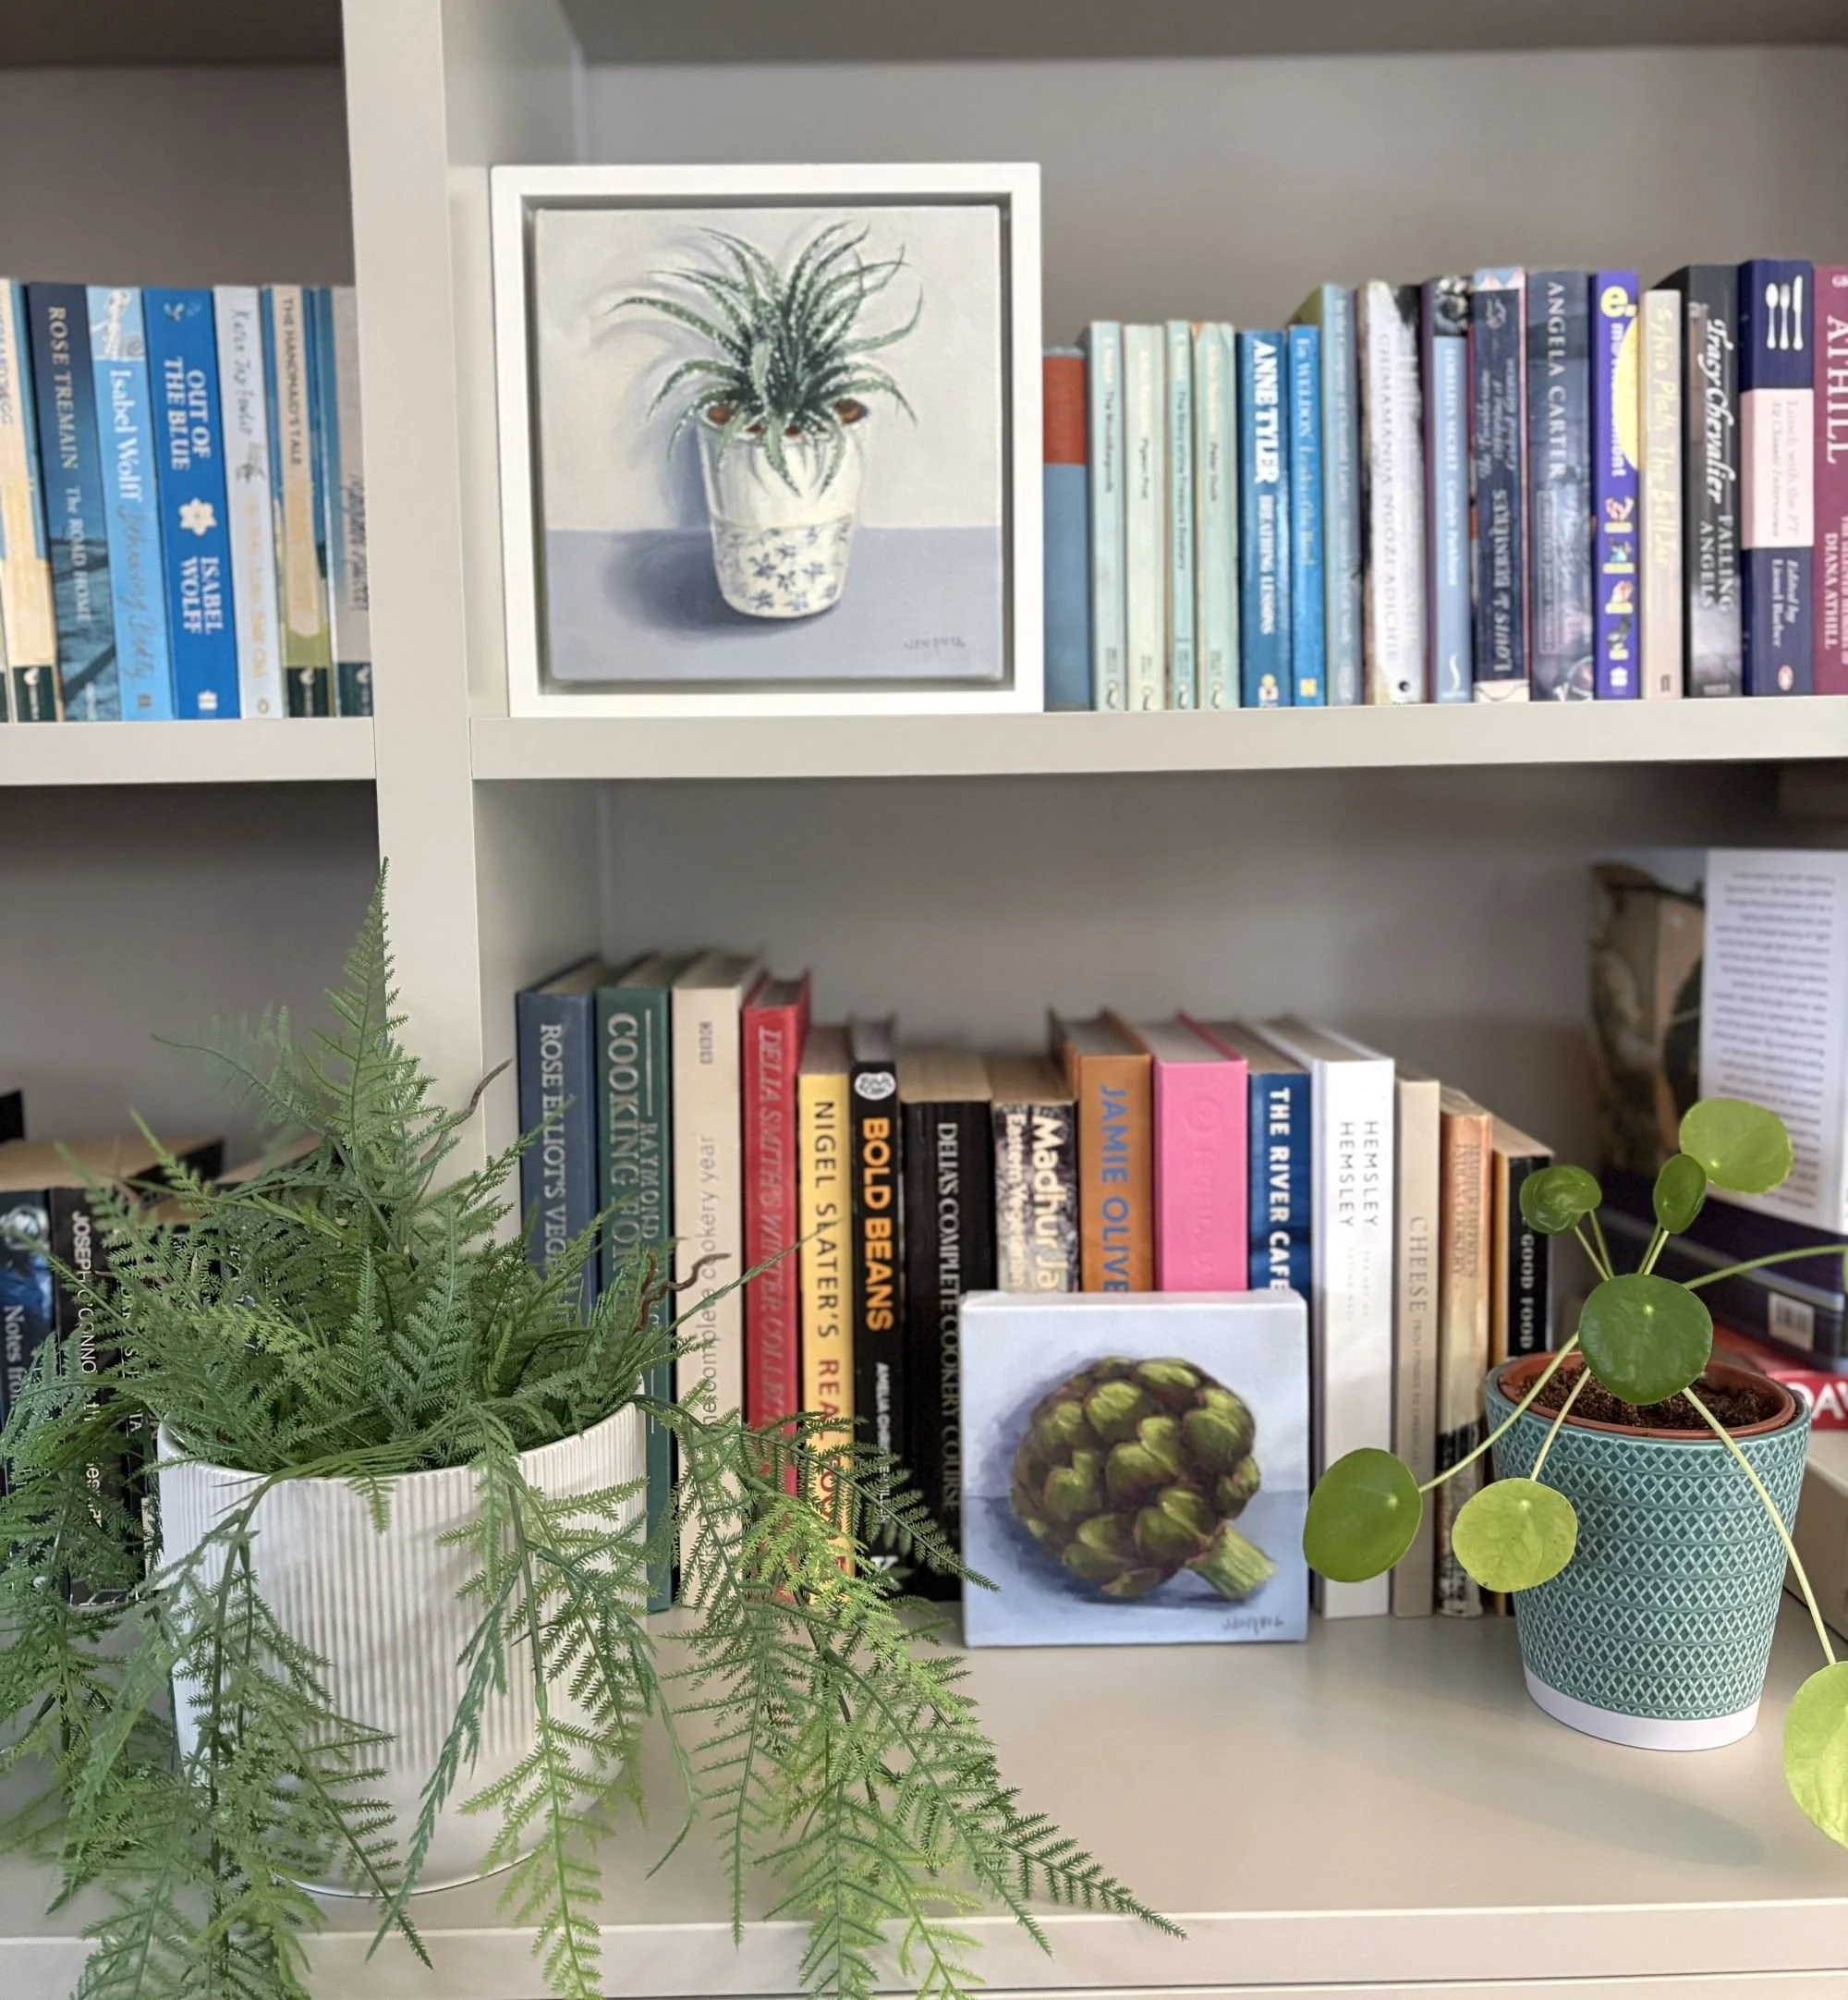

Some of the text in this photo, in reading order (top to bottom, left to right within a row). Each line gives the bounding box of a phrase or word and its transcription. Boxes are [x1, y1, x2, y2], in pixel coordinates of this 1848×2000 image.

[282, 298, 294, 325] THE
[1649, 308, 1675, 372] Sylvia
[110, 370, 139, 433] Isabel
[164, 357, 191, 470] THE BLUE
[186, 370, 212, 459] OUT OF
[284, 329, 300, 427] HANDMAID'S
[1253, 339, 1280, 407] ANNE
[1548, 281, 1569, 480] ANGELA CARTER
[1651, 378, 1679, 431] Plath
[1697, 318, 1736, 505] Tracy Chevalier
[1827, 314, 1848, 465] ATHILL
[49, 306, 91, 622] ROSE TREMAIN The ROAD HOME
[116, 437, 145, 504] Wolff
[288, 429, 303, 467] TALE
[1254, 408, 1281, 486] TYLER
[1650, 443, 1677, 483] The
[1379, 333, 1400, 664] CHIMAMANDA NGOZI ADICHIE
[1651, 487, 1679, 534] Bell
[1787, 486, 1800, 512] the
[180, 556, 201, 634] WOLFF
[200, 556, 225, 635] ISABEL
[1700, 520, 1716, 609] ANGELS
[1719, 515, 1734, 611] FALLING
[1786, 559, 1801, 605] Edited
[1824, 532, 1839, 651] DIANA ATHILL
[1492, 612, 1514, 673] LOUIS
[540, 1023, 564, 1089] ROSE
[758, 1025, 784, 1104] DELIA
[541, 1093, 567, 1199] ELLIOT'S
[607, 1012, 640, 1272] COOKING FOR
[814, 1101, 837, 1189] NIGEL
[1005, 1112, 1028, 1184] Eastern
[1269, 1087, 1291, 1136] THE
[638, 1122, 661, 1239] RAYMOND
[698, 1134, 722, 1184] year
[861, 1116, 892, 1210] BOLD
[1032, 1115, 1070, 1248] Madhur
[1100, 1083, 1130, 1292] JAMIE OLIVE
[1269, 1146, 1291, 1223] RIVER
[1339, 1120, 1355, 1228] HEMSLEY
[1363, 1120, 1379, 1227] HEMSLEY
[73, 1211, 91, 1283] JOSEPH
[759, 1213, 784, 1312] WINTER
[815, 1203, 839, 1338] SLATER'S
[864, 1216, 894, 1331] BEANS
[939, 1197, 961, 1311] COMPLETE
[1407, 1215, 1429, 1313] CHEESE
[1520, 1233, 1536, 1349] GOOD FOOD
[4, 1303, 28, 1407] Notes fro
[759, 1316, 785, 1429] COLLECT
[940, 1314, 960, 1417] COOKERY
[942, 1424, 960, 1511] COURSE
